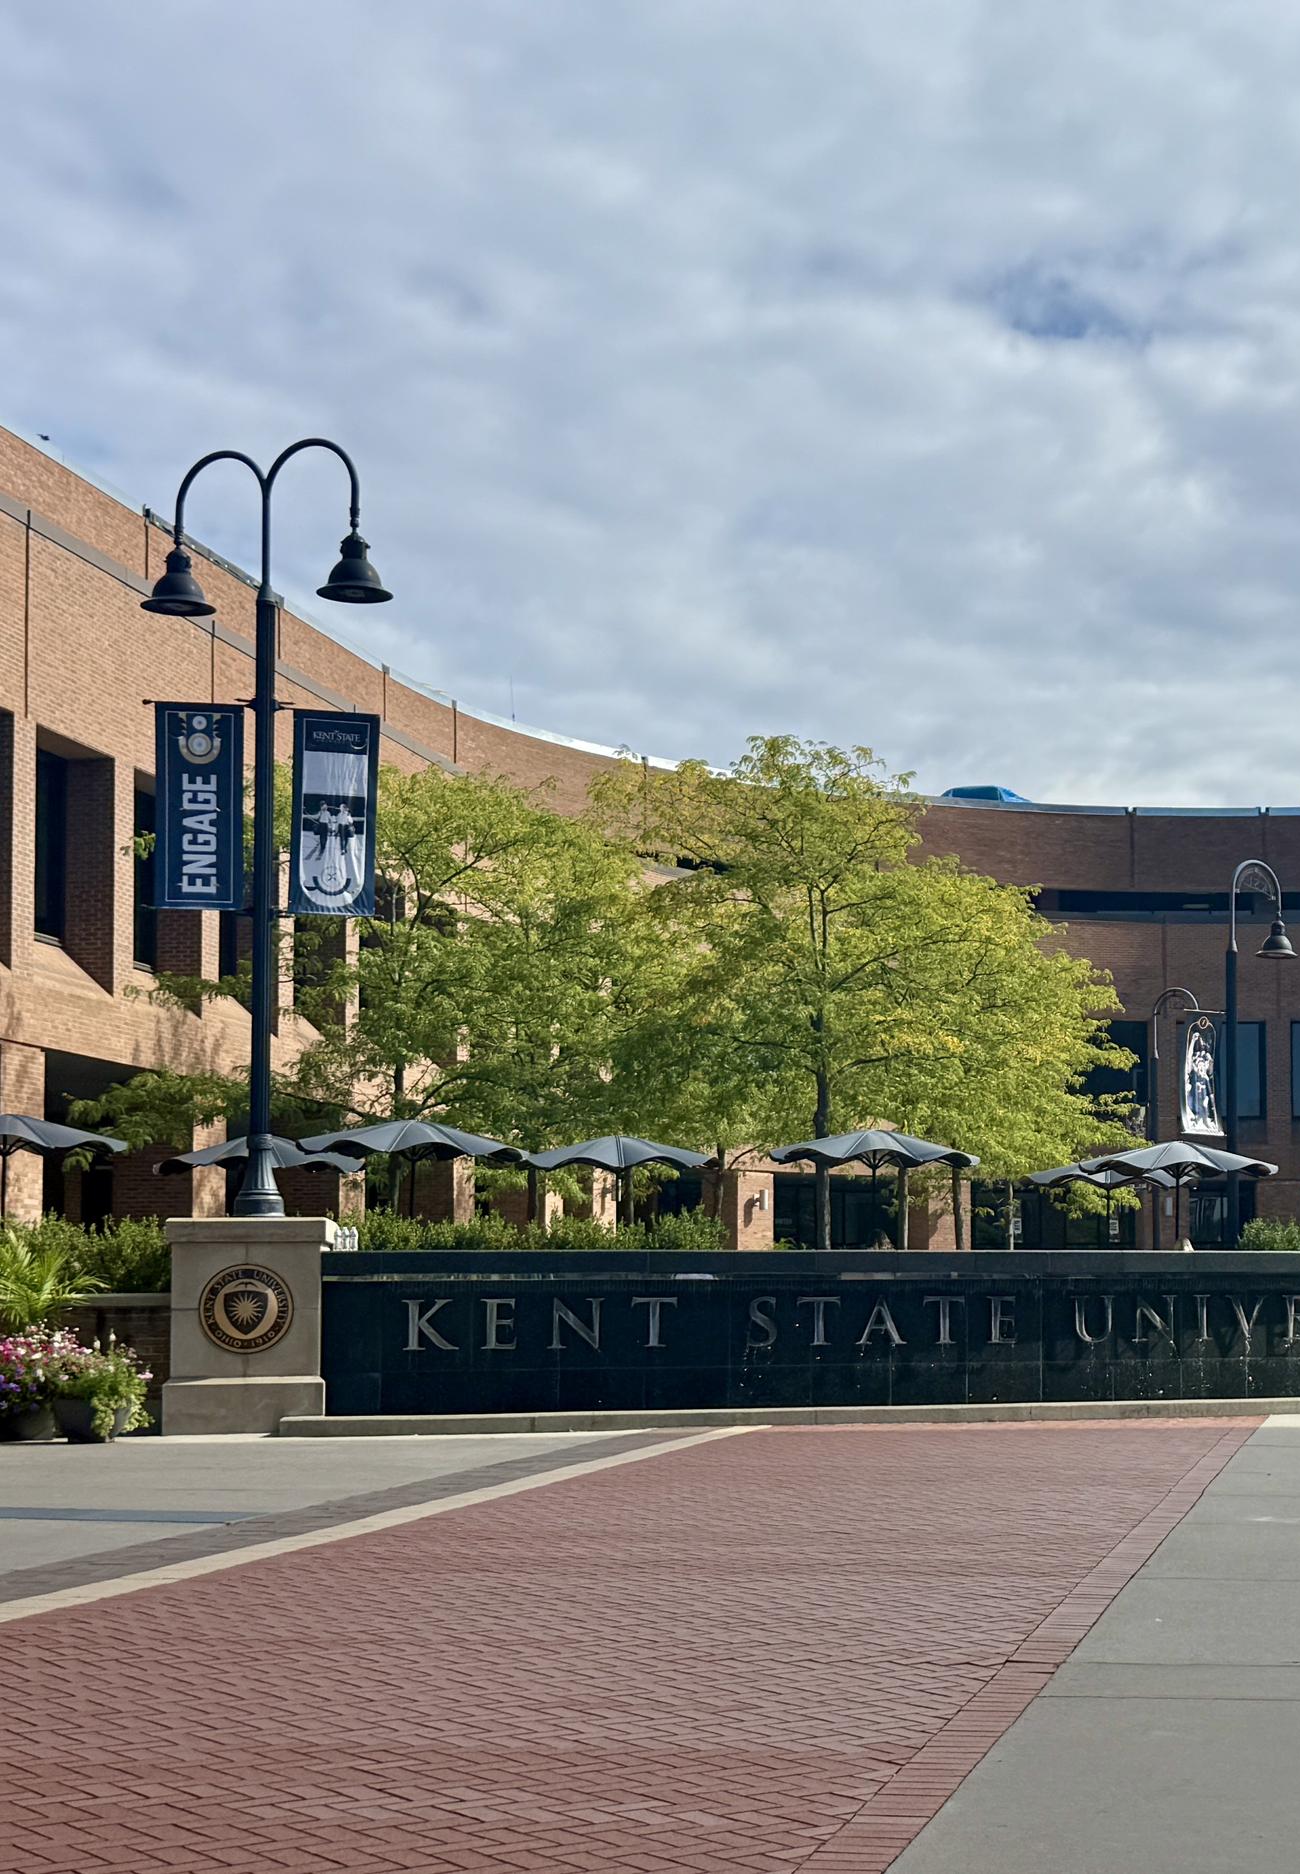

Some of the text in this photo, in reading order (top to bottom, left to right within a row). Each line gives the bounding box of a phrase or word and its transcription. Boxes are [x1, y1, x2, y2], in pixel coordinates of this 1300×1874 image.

[313, 731, 336, 740] KENT
[337, 732, 360, 742] STATE
[182, 773, 217, 893] ENGAGE
[213, 1270, 245, 1291] STATE
[402, 1296, 678, 1352] KENT
[747, 1295, 1018, 1348] STATE
[215, 1330, 242, 1348] OHIO
